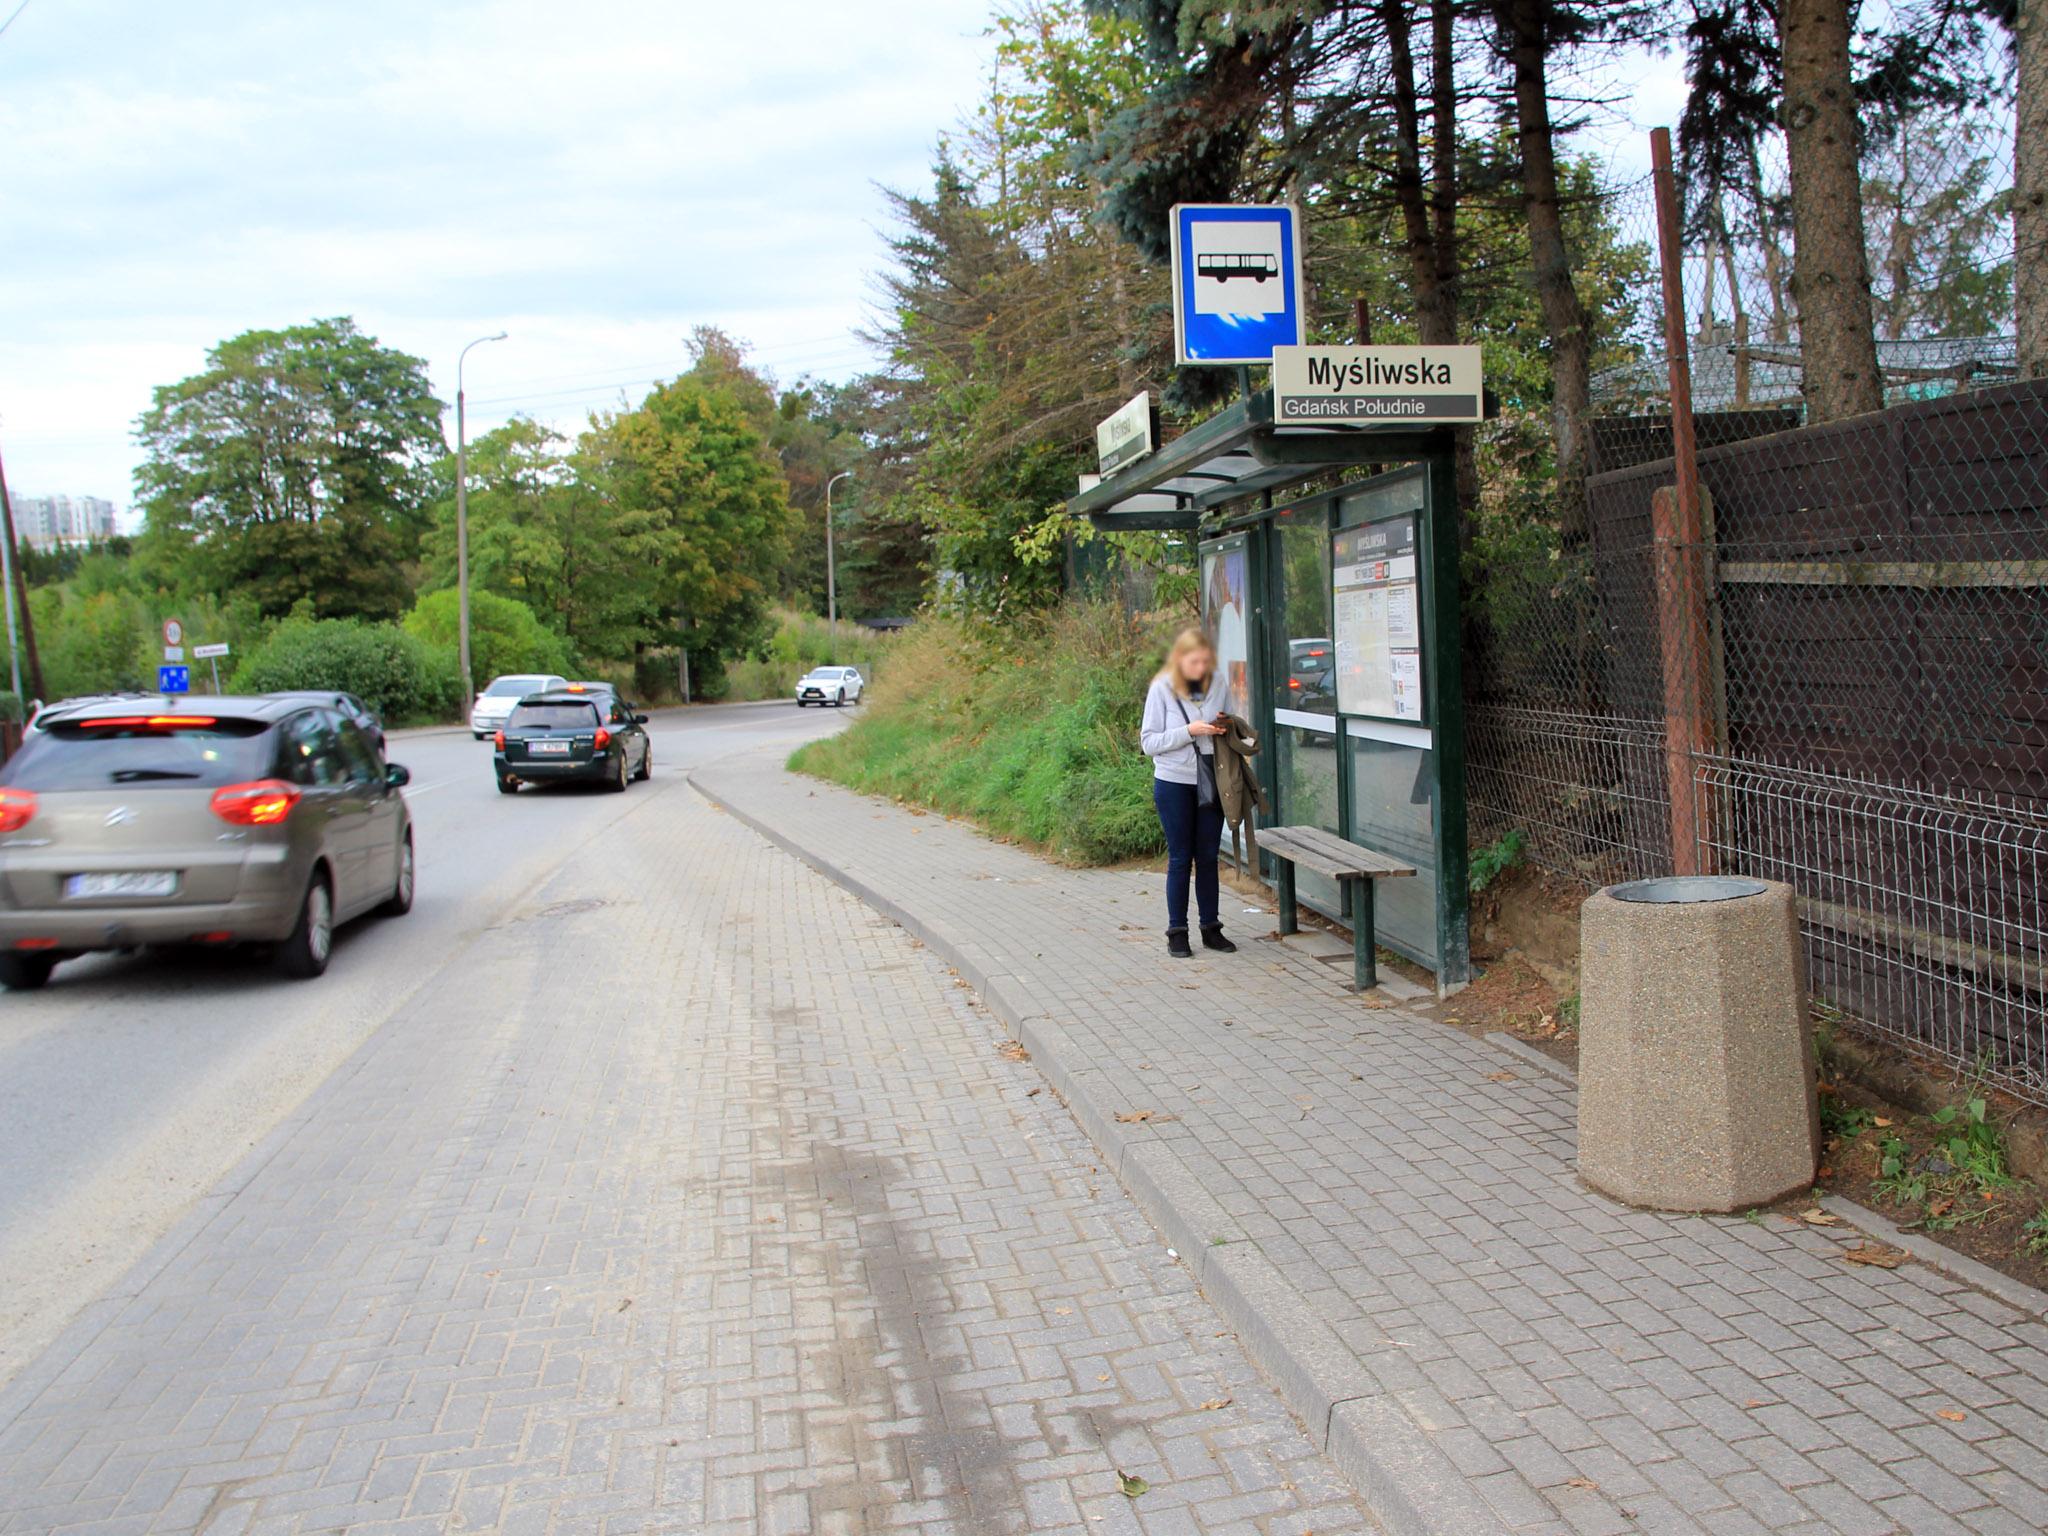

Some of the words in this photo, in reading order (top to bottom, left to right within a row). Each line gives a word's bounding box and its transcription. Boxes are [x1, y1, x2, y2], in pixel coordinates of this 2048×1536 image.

[1308, 357, 1451, 392] Myśliwska
[1285, 399, 1349, 415] Gdańsk
[1354, 399, 1425, 415] Południe
